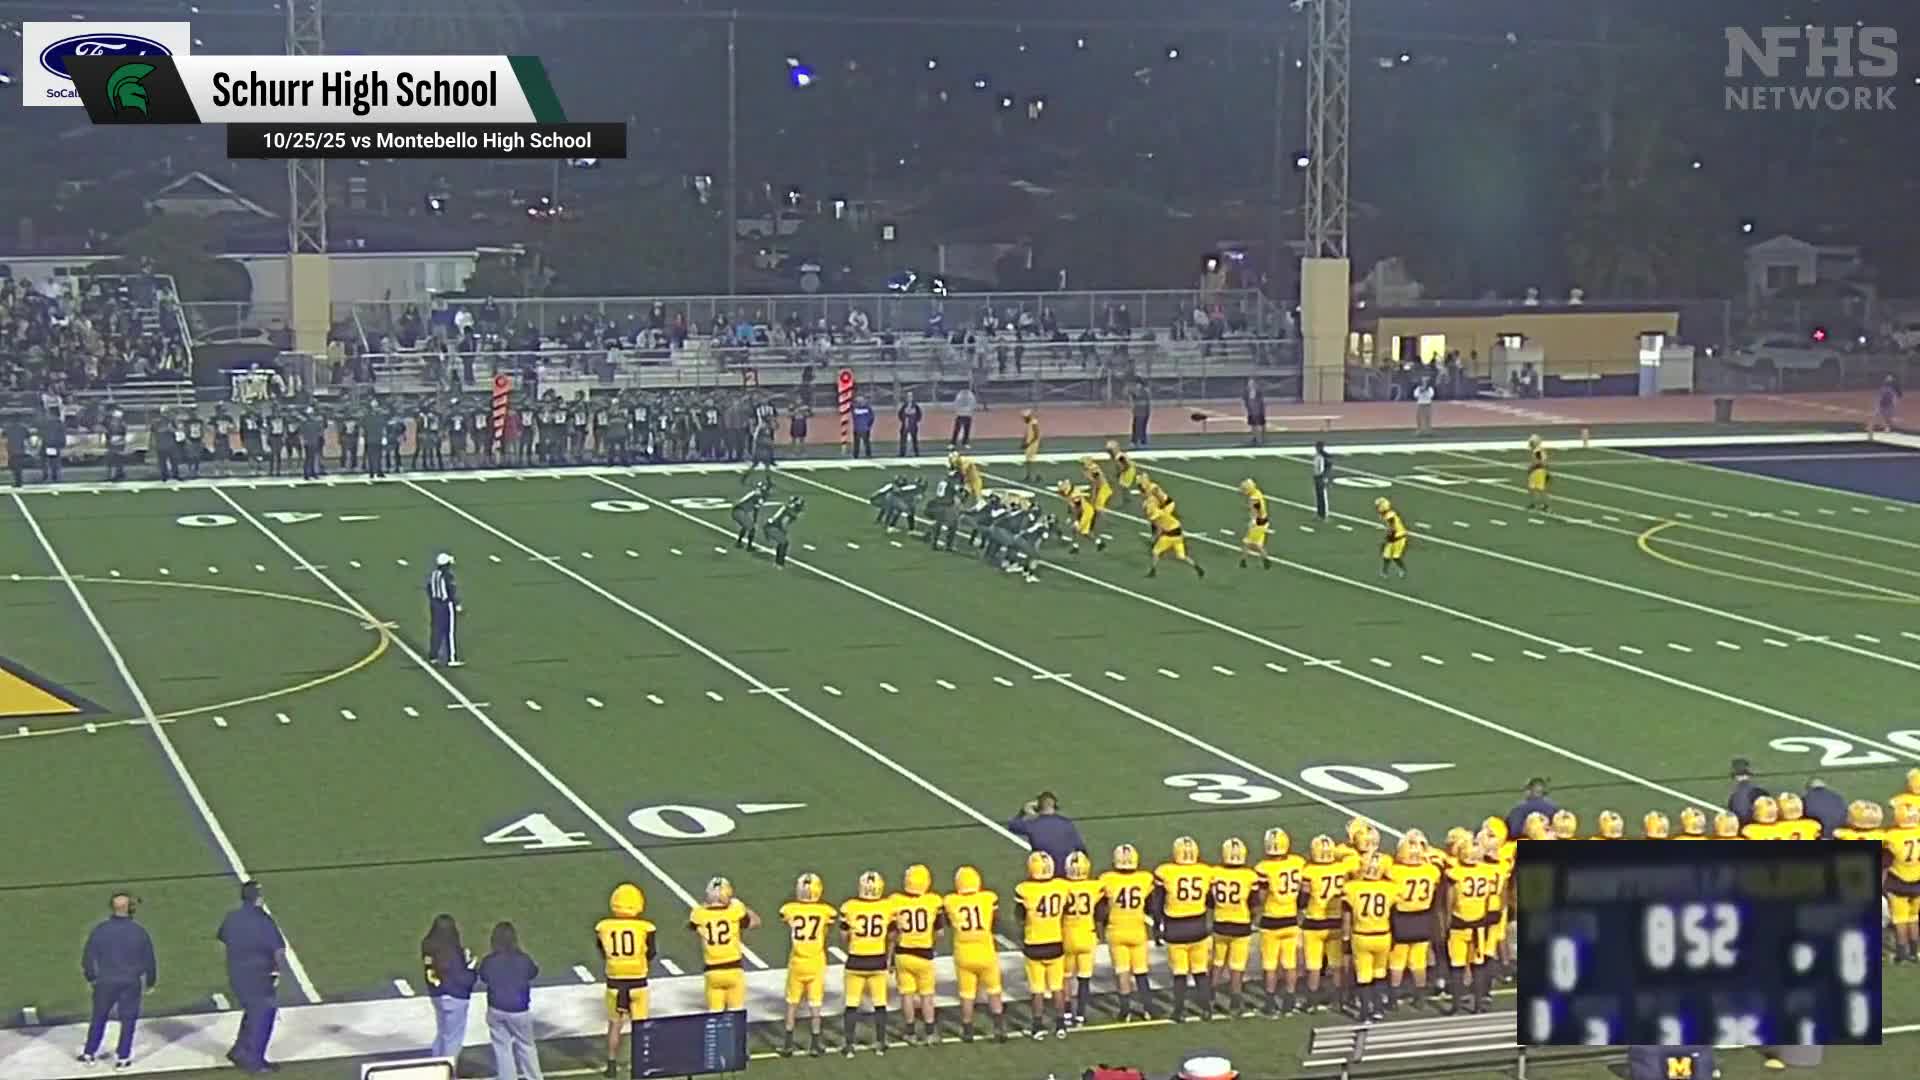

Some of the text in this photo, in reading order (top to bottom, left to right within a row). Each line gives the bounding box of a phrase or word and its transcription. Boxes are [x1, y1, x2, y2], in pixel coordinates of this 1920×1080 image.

[1177, 876, 1203, 901] 65
[1215, 880, 1241, 904] 62
[1279, 869, 1300, 895] 35
[1404, 878, 1431, 901] 73
[1463, 876, 1488, 897] 32
[1036, 893, 1061, 918] 40
[1064, 892, 1091, 916] 23
[1115, 886, 1141, 909] 46
[1359, 892, 1386, 917] 78
[793, 916, 821, 940] 27
[855, 914, 883, 938] 36
[901, 908, 928, 933] 30
[959, 905, 984, 931] 31
[610, 930, 635, 956] 10
[705, 920, 730, 945] 12
[1667, 1056, 1692, 1079] M
